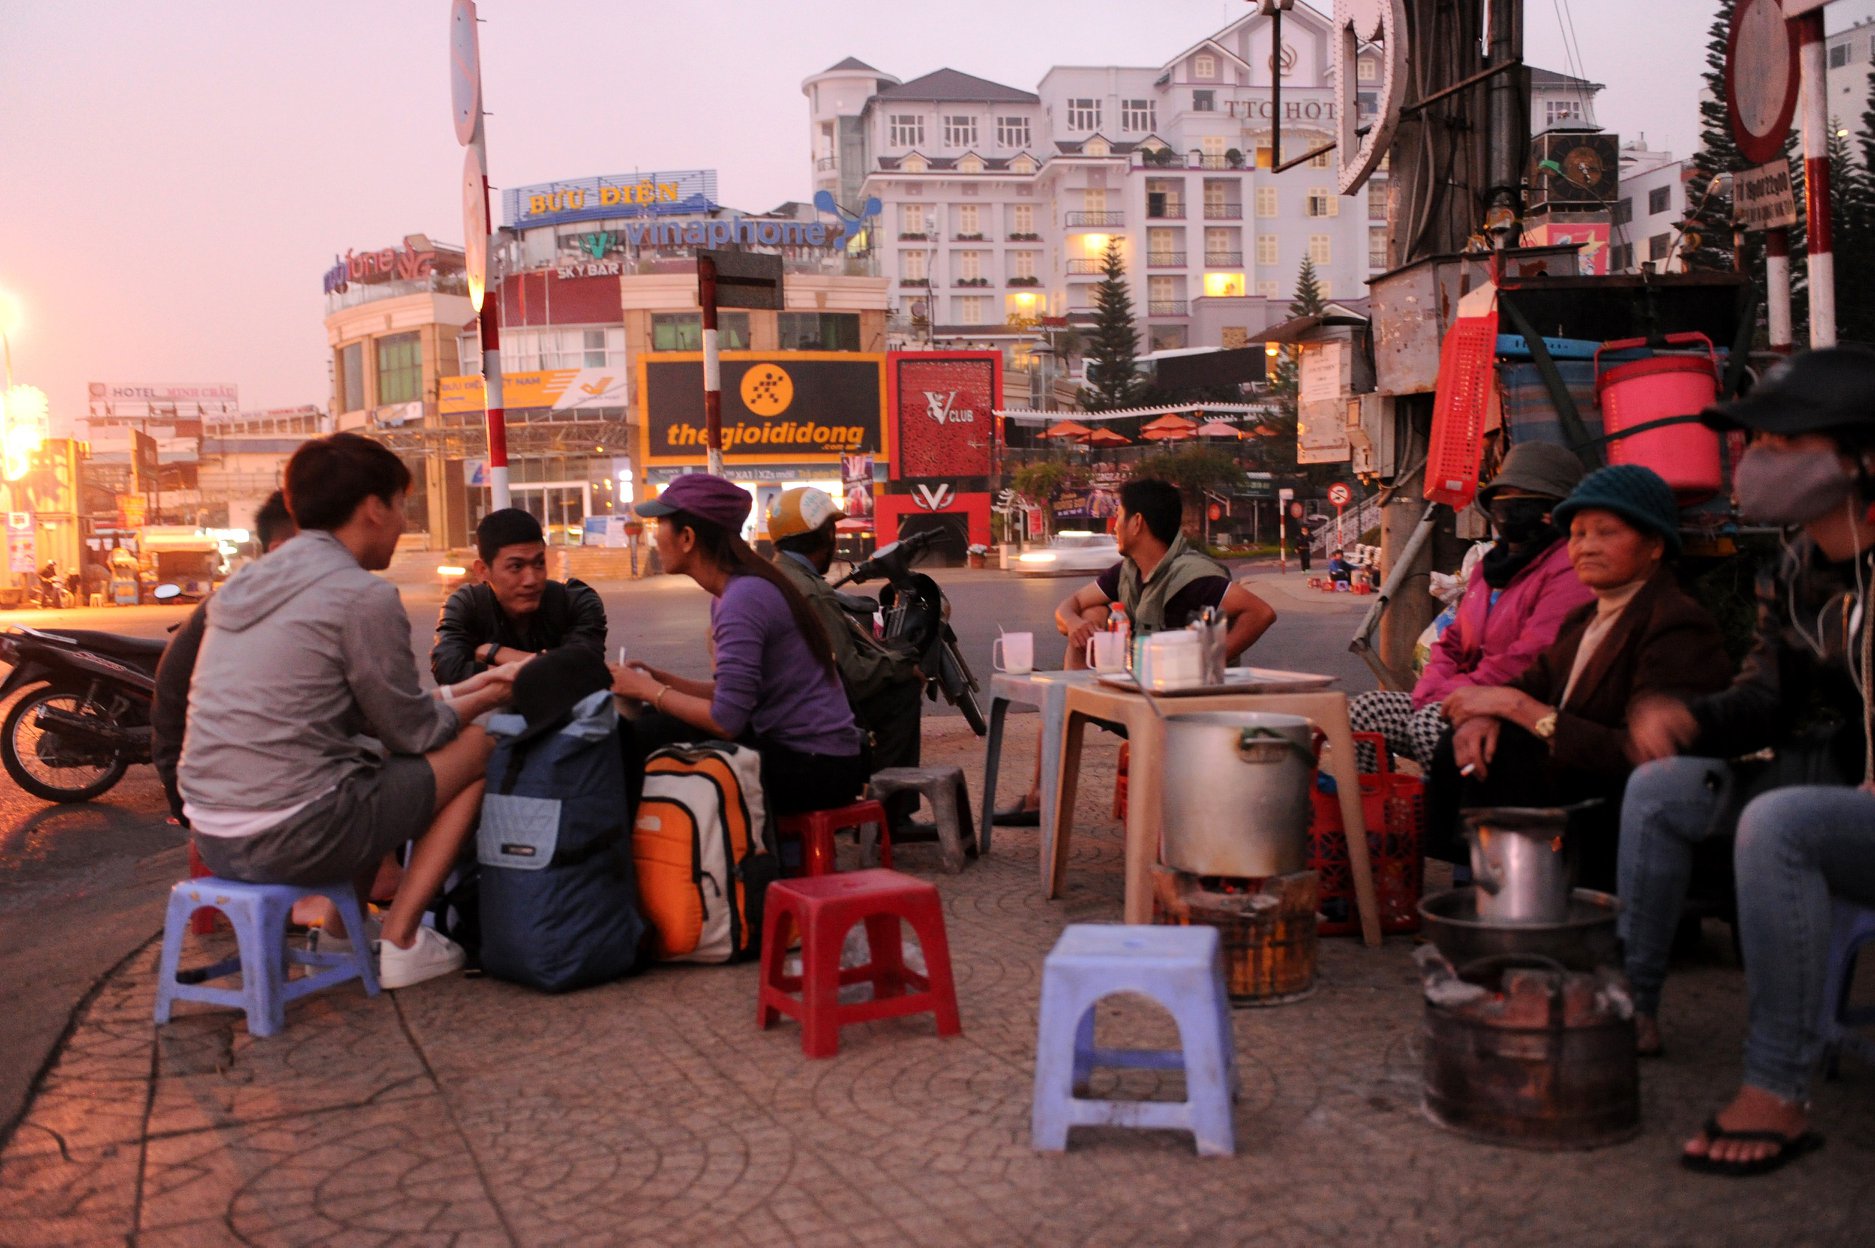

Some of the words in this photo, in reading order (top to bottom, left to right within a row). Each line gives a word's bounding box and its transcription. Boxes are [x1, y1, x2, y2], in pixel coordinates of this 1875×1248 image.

[529, 188, 585, 215] BƯU
[599, 179, 678, 208] ĐIỆN
[625, 215, 826, 250] vinaphone
[588, 263, 619, 276] BAR
[113, 387, 156, 398] HOTEL
[949, 409, 974, 423] CLUB
[667, 421, 865, 451] thegioididong
